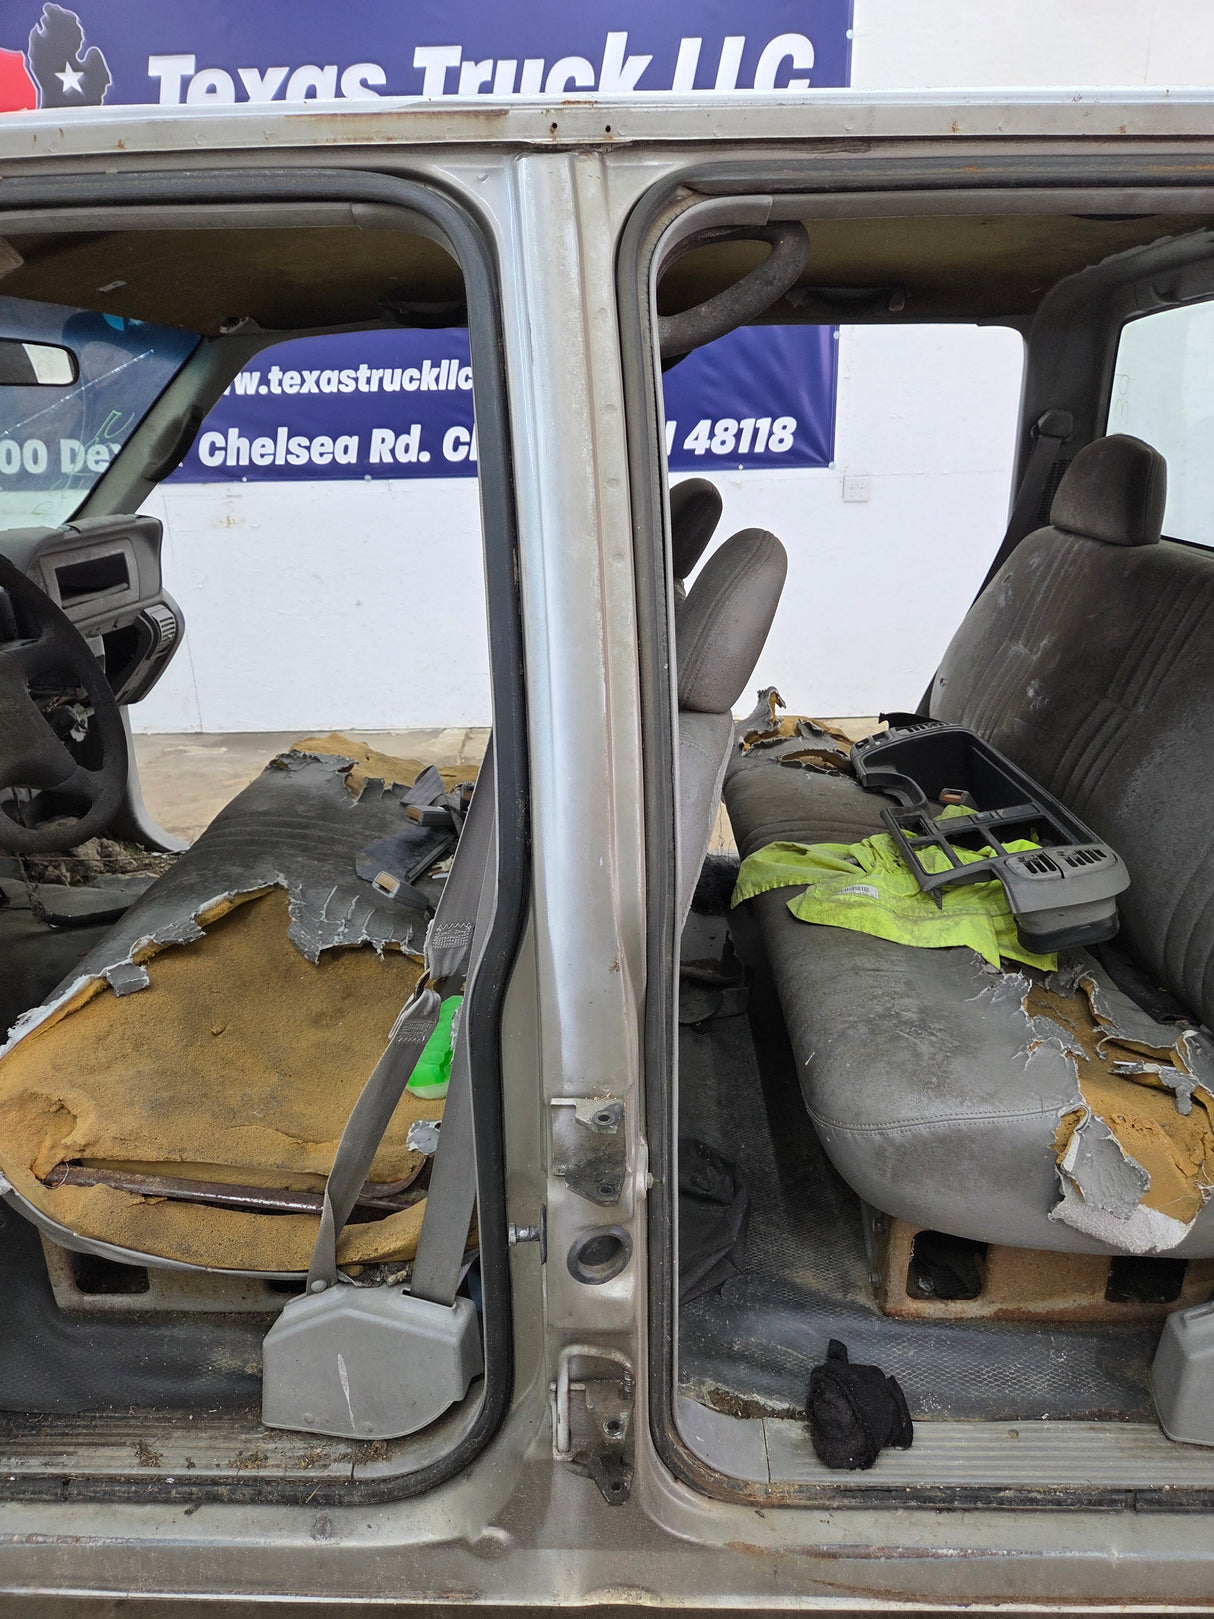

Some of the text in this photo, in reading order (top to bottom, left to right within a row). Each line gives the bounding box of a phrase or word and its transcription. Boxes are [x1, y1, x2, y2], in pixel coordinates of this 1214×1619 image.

[412, 31, 653, 95] Truck
[198, 426, 359, 467] Chelsea
[369, 424, 431, 464] Rd.
[683, 416, 797, 455] 48118
